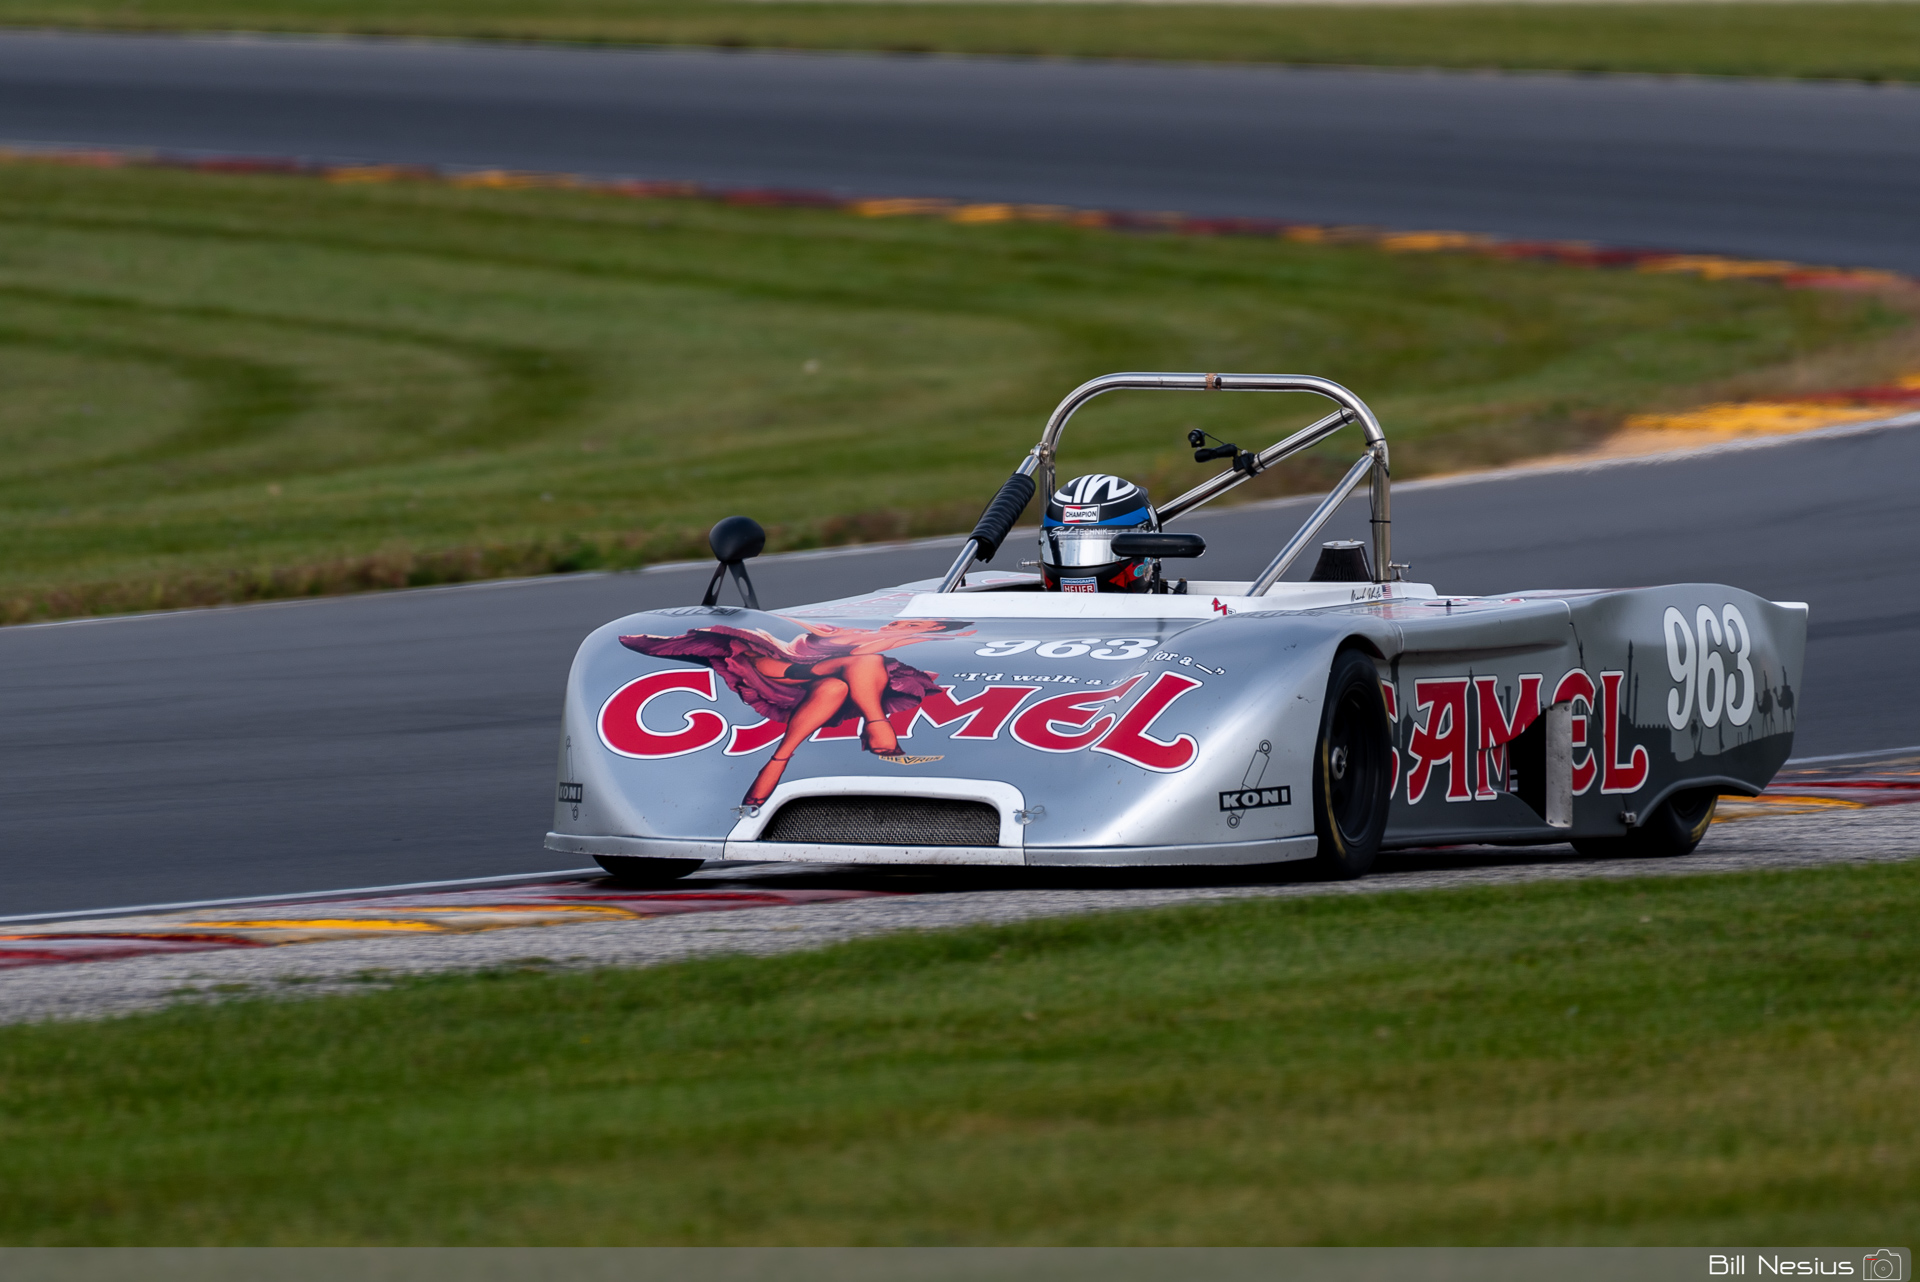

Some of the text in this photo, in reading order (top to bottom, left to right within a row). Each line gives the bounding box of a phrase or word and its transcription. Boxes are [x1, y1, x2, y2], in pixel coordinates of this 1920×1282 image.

[1065, 510, 1097, 518] CHAMPION
[975, 638, 1159, 660] 963
[1150, 650, 1179, 662] for
[1181, 656, 1193, 666] a
[1663, 603, 1755, 731] 963
[1011, 674, 1080, 685] walk
[1086, 677, 1103, 686] a
[1381, 667, 1650, 806] AMEL
[1223, 786, 1290, 809] KONI
